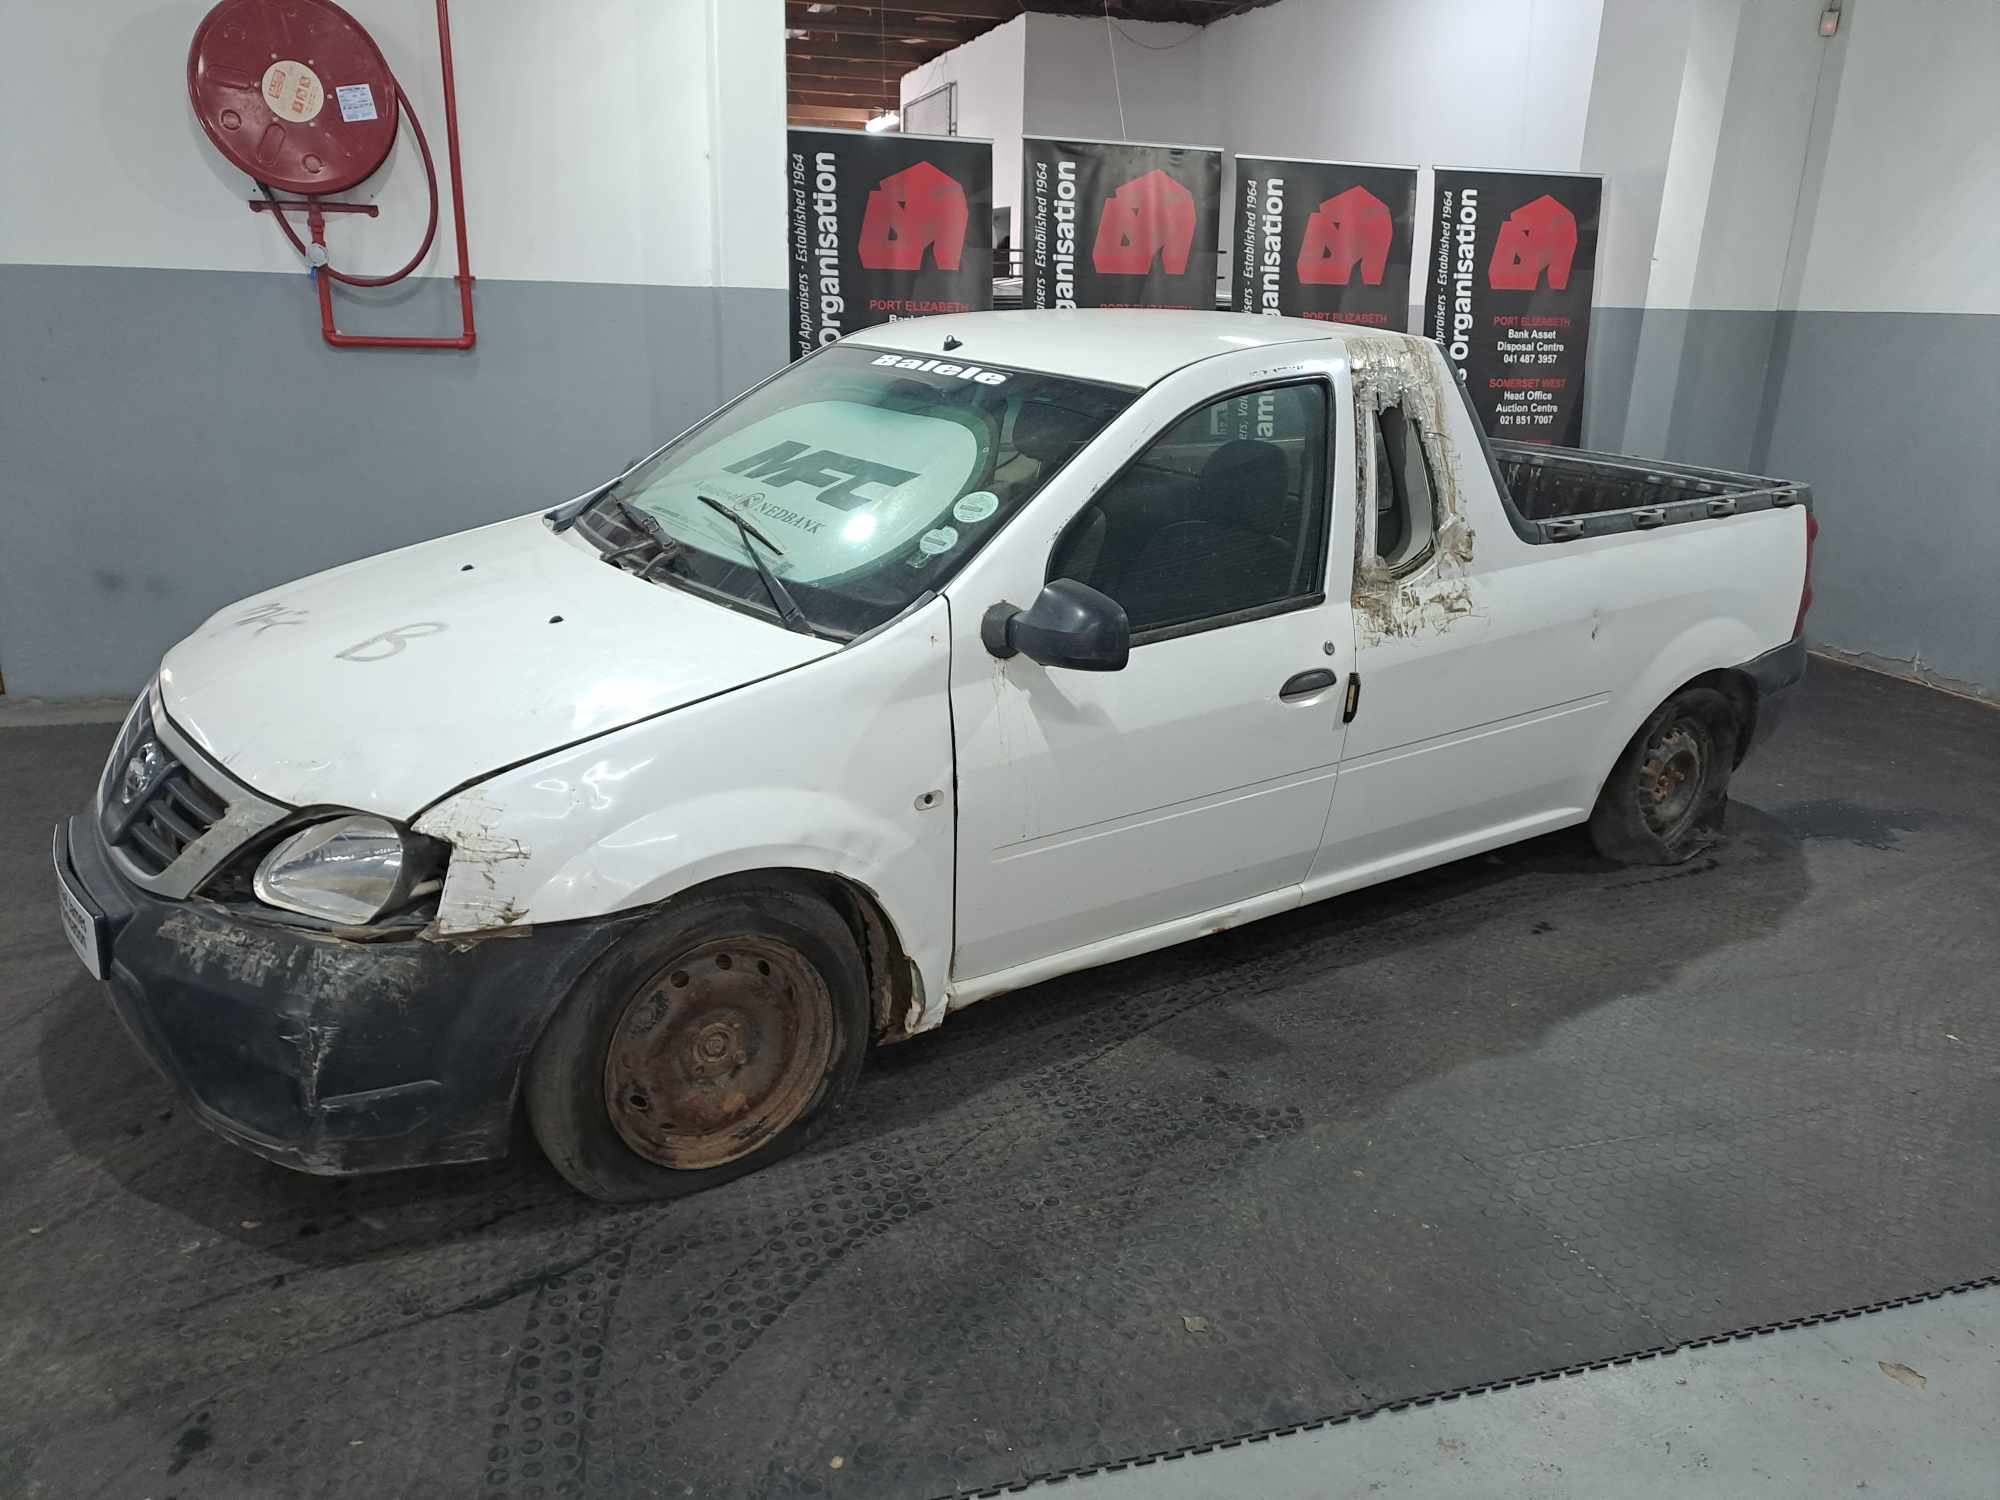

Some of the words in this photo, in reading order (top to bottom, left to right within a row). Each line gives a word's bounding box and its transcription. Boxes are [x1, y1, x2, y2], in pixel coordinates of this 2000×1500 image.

[792, 153, 806, 185] 1964
[1036, 162, 1048, 194] 1964
[1246, 179, 1258, 208] 1964
[1442, 190, 1454, 218] 1964
[793, 188, 808, 261] Established
[1034, 196, 1047, 267] Established
[1053, 161, 1077, 310] ganisation
[813, 152, 845, 347] Organisation
[1243, 211, 1257, 278] Established
[1437, 220, 1451, 285] Established
[1450, 188, 1478, 360] Organisation
[796, 273, 813, 339] Appraisers
[869, 299, 901, 311] PORT
[905, 301, 970, 312] ELIZABETH
[1434, 294, 1447, 345] ppraisers
[1494, 315, 1518, 326] PORT
[799, 340, 811, 357] nd
[1497, 341, 1535, 352] Disposal
[1536, 341, 1565, 352] Centre
[1508, 328, 1529, 339] Bank
[1531, 329, 1557, 339] Asset
[870, 354, 1008, 385] Balele
[1503, 353, 1518, 364] 041
[1519, 354, 1535, 364] 487
[1537, 354, 1558, 364] 3957
[1488, 377, 1540, 389] SOMERSET
[1542, 378, 1567, 389] WEST
[1503, 390, 1525, 401] Head
[1526, 390, 1553, 401] Office
[1495, 402, 1529, 413] Auction
[1530, 402, 1559, 413] Centre
[1499, 415, 1514, 425] 021
[1515, 415, 1531, 425] 851
[1533, 415, 1554, 425] 7007
[755, 502, 826, 534] NEDBANK
